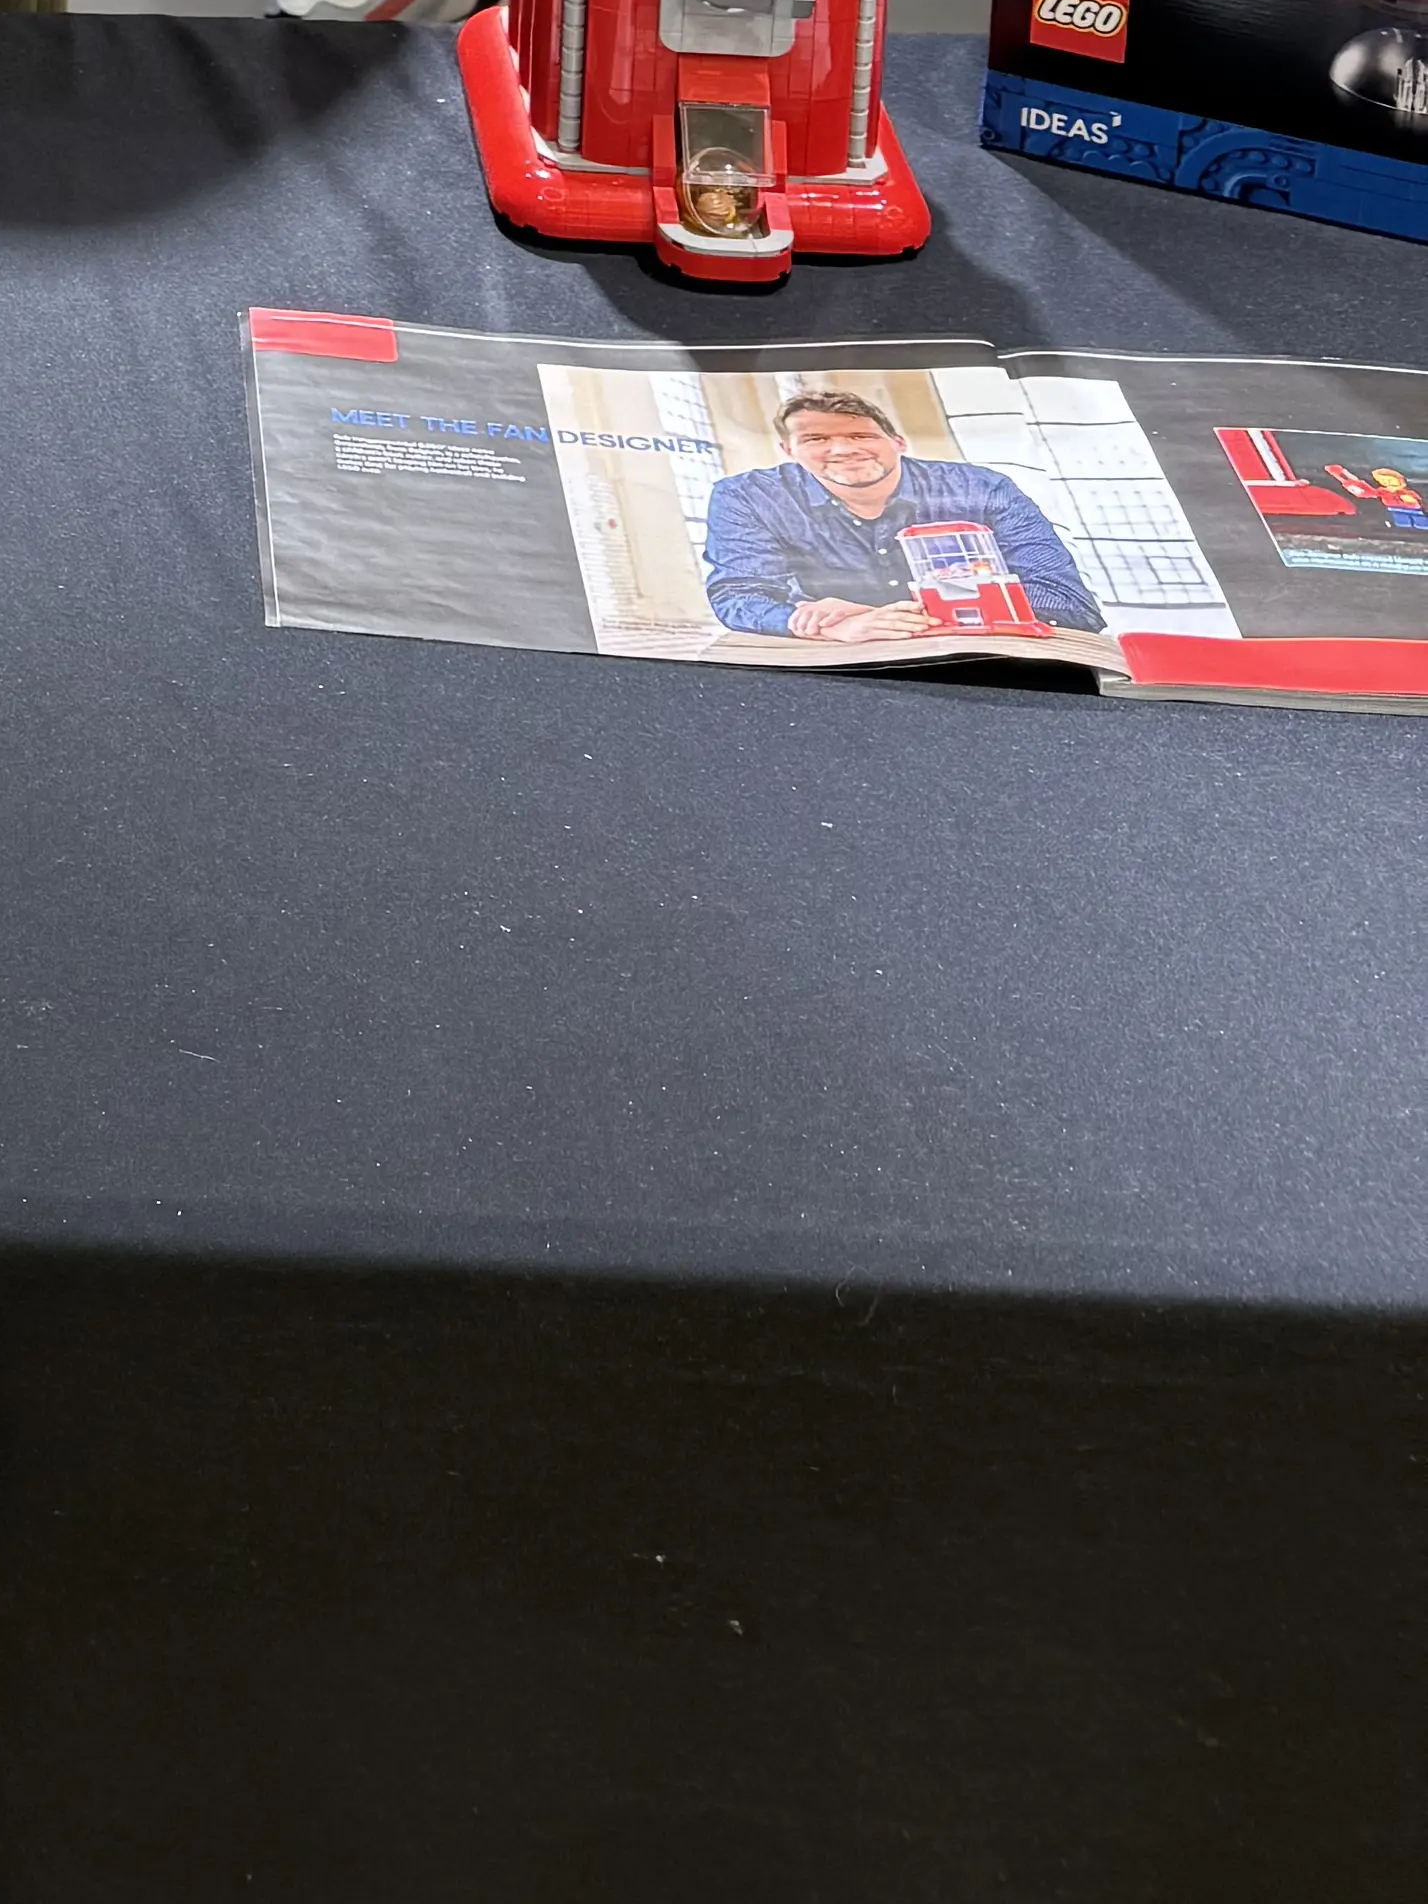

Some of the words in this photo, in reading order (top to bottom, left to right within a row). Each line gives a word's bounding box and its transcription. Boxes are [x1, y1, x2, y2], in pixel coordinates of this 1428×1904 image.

[1019, 106, 1109, 145] IDEAS
[330, 407, 409, 430] MEET
[420, 414, 478, 436] THE
[485, 422, 550, 444] FAN
[557, 429, 716, 456] DESIGNER
